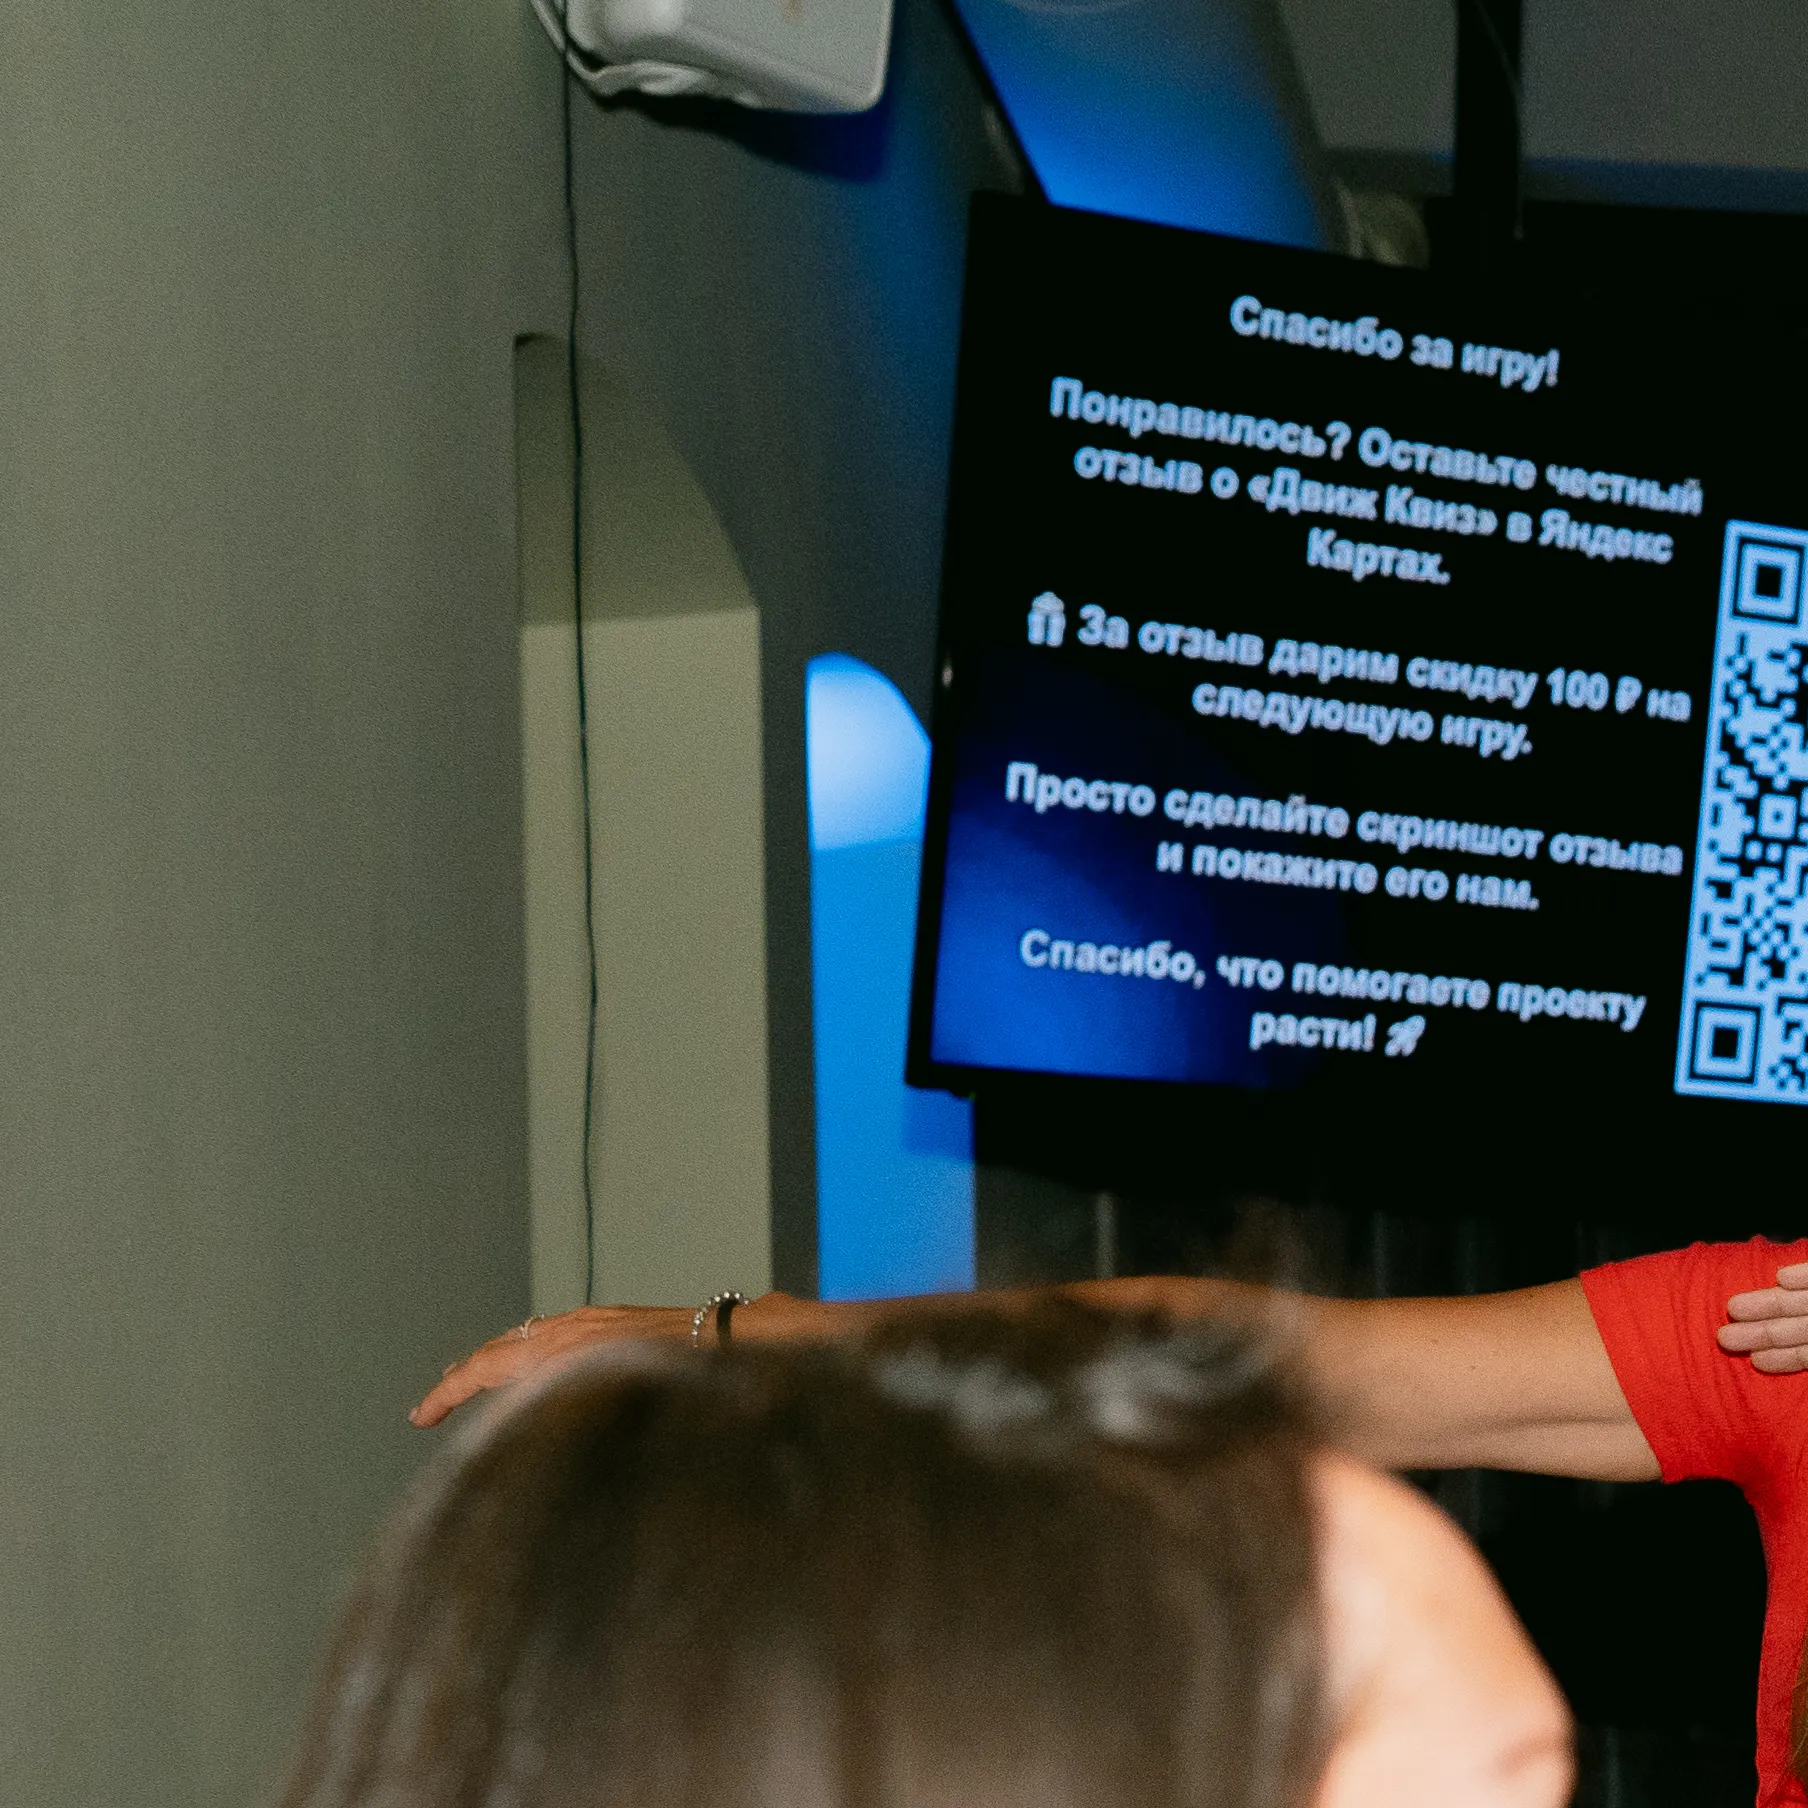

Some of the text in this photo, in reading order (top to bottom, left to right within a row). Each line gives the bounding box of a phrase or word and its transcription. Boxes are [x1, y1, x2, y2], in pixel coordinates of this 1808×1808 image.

[1231, 297, 1560, 392] Спасибо за игру!
[1050, 379, 1703, 515] Понравилось? Оставьте честный
[1075, 447, 1203, 494] отзыв
[1212, 469, 1240, 499] о
[1247, 469, 1379, 521] «Движ
[1506, 512, 1532, 543] в
[1537, 509, 1673, 564] Яндекс
[1306, 527, 1450, 584] Картах.
[1077, 605, 1129, 649] За
[1138, 621, 1264, 666] отзыв
[1267, 639, 1399, 684] дарим
[1406, 657, 1539, 709] скидку
[1546, 668, 1609, 711] 100
[1646, 689, 1691, 722] на
[1192, 683, 1533, 761] следующую игру.
[1006, 762, 1683, 875] Просто сделайте скриншот отзыва
[1156, 842, 1540, 910] и покажите его нам.
[1020, 930, 1647, 1032] Спасибо, что помогаете проекту
[1249, 1013, 1377, 1052] расти!
